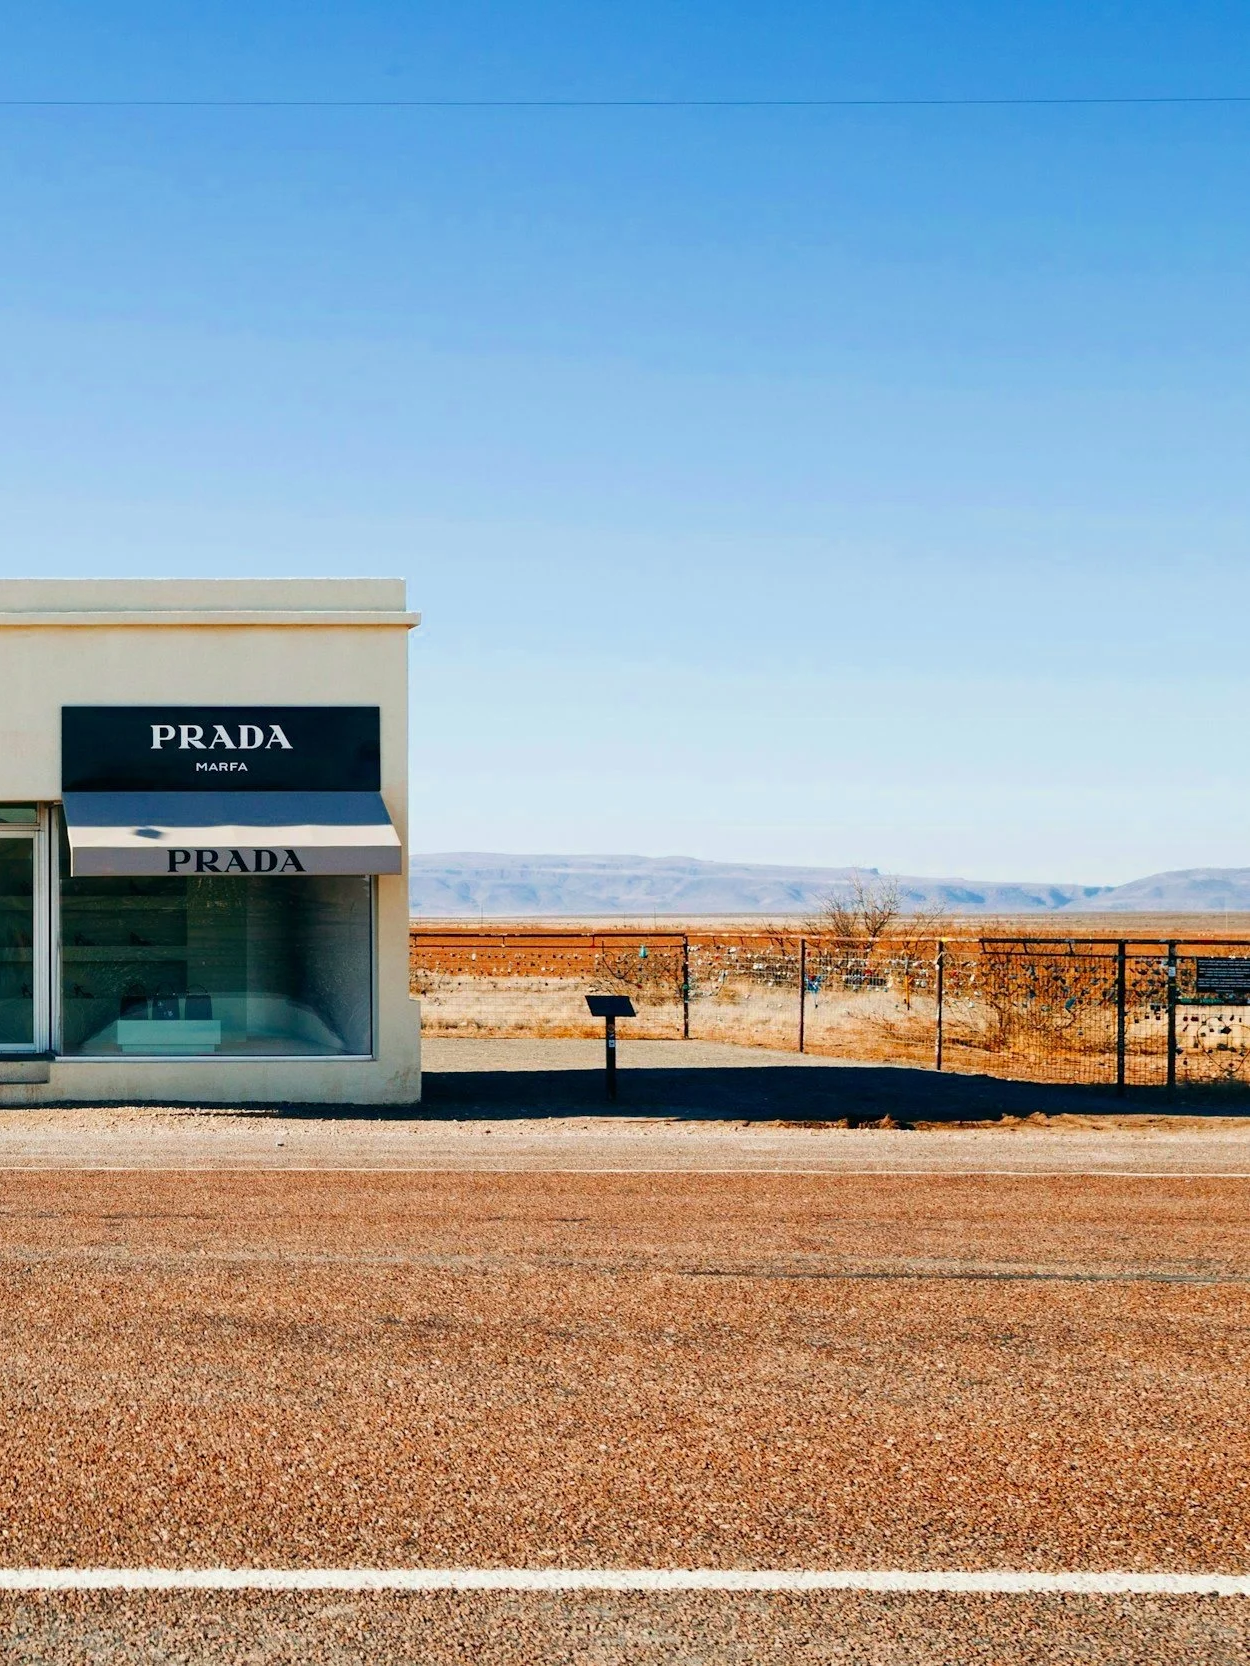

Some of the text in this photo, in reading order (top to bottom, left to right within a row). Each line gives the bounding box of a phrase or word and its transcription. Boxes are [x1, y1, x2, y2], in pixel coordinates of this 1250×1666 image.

[150, 724, 293, 750] PRADA
[195, 762, 248, 772] MARFA
[167, 849, 306, 873] PRADA
